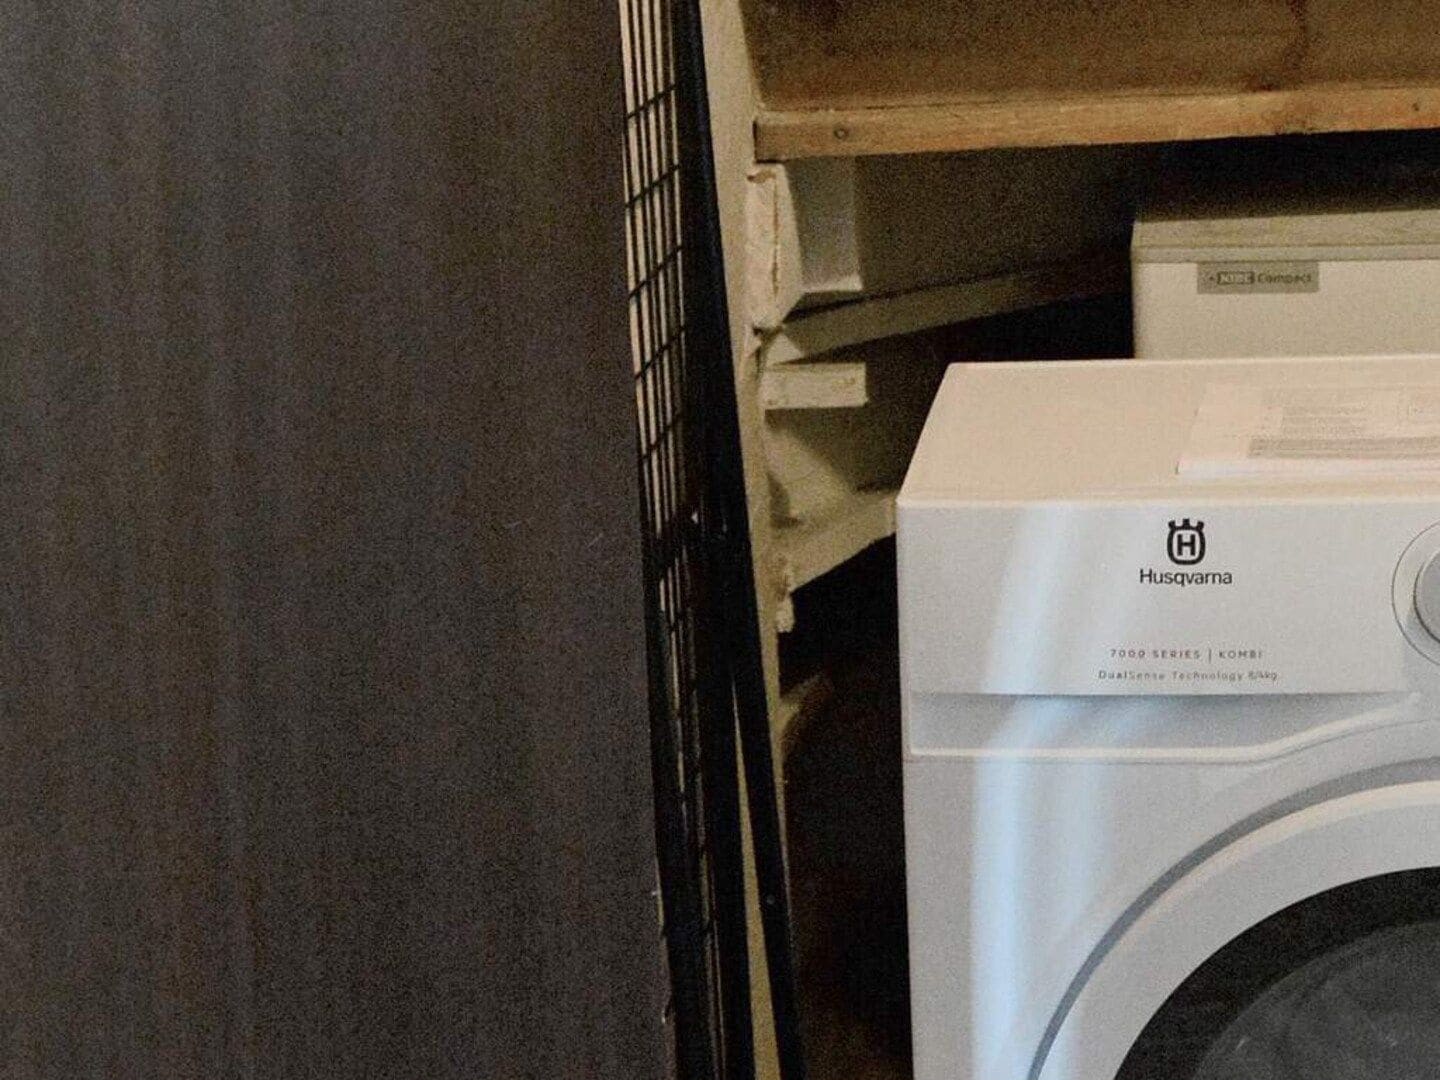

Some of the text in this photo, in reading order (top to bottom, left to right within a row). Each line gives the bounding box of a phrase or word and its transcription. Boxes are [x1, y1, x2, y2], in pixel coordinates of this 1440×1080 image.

[1139, 568, 1232, 587] Husqvarna
[1110, 649, 1263, 659] 7000 SERIES KOMBI
[1098, 669, 1165, 680] DualSense
[1171, 670, 1244, 682] Technology
